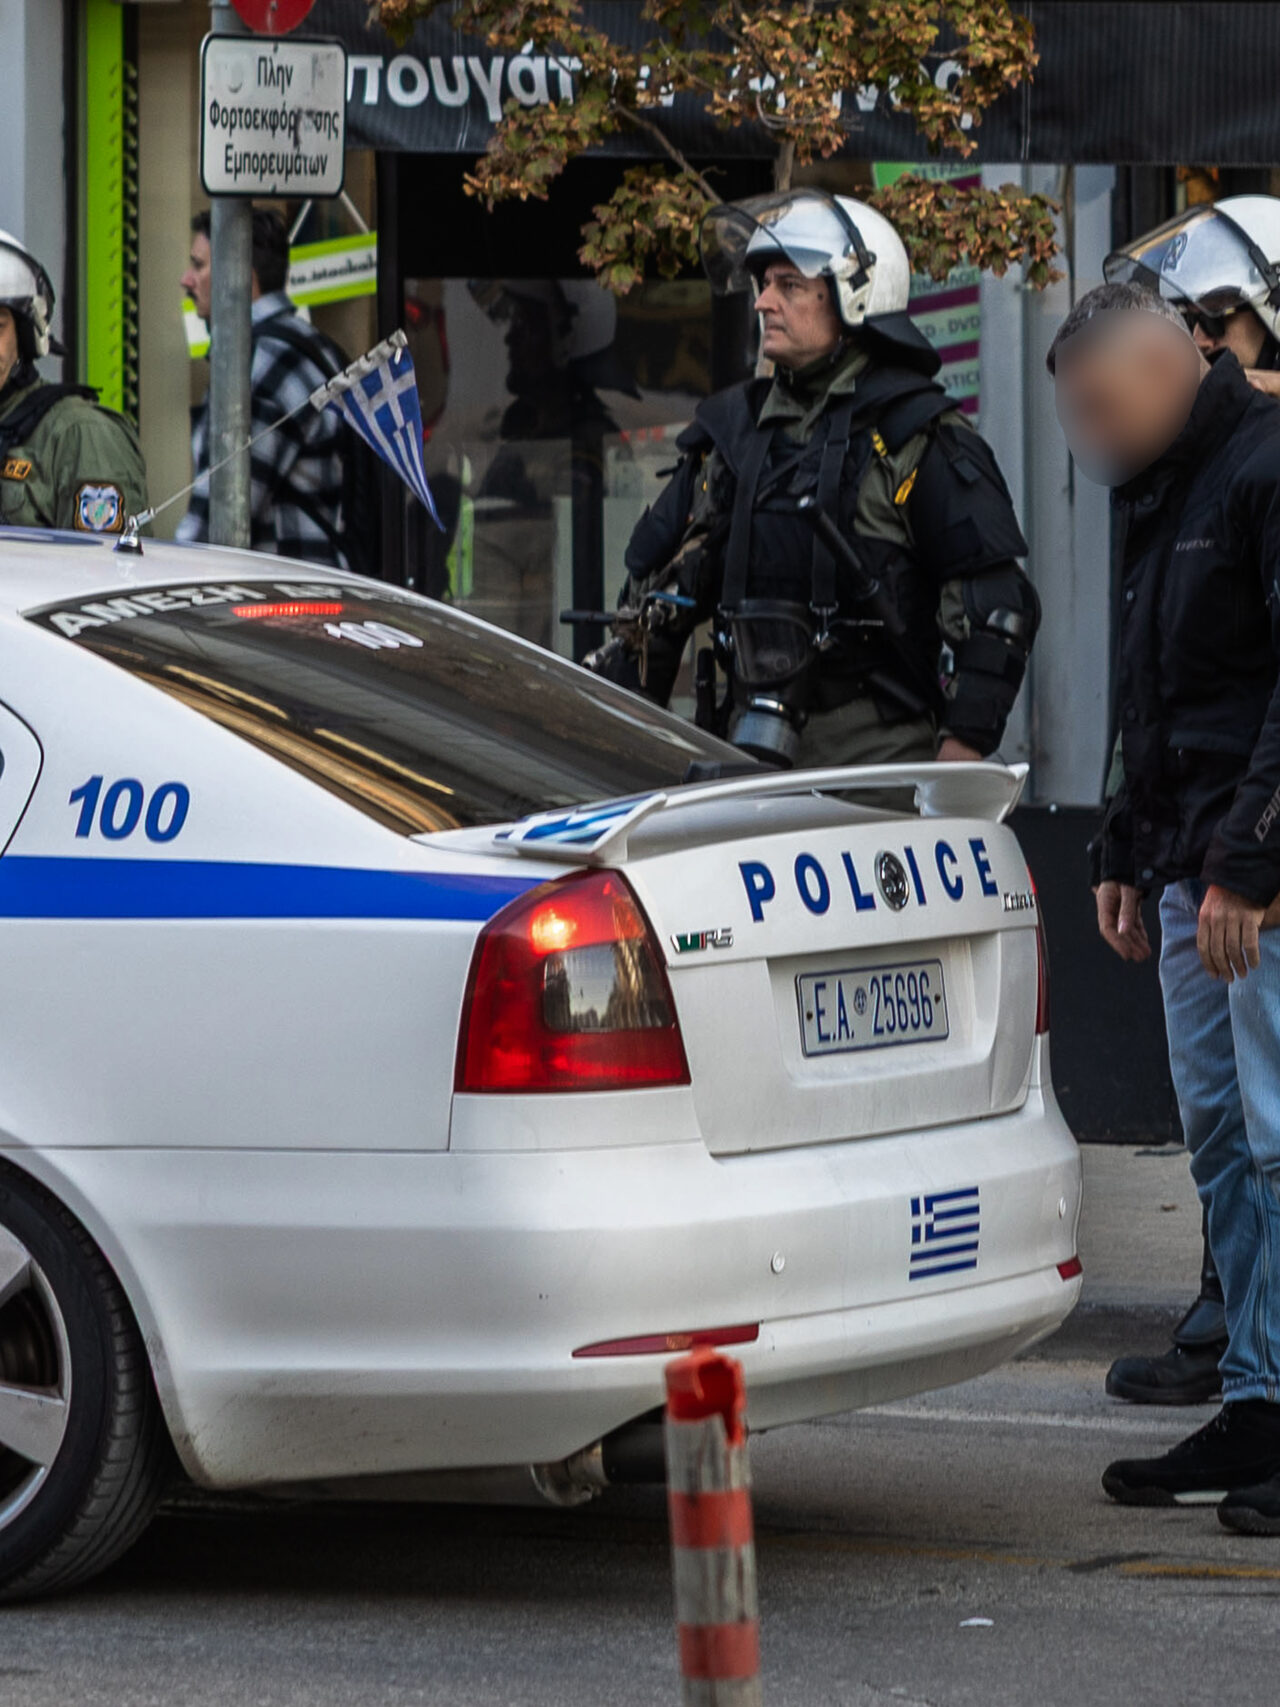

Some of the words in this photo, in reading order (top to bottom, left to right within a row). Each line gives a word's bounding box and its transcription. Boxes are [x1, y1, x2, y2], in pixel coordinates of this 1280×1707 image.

[257, 56, 294, 95] Πλην
[209, 98, 340, 141] Φορτοεκφόρσης
[224, 143, 329, 182] Εμπορευμάτων
[49, 584, 268, 639] ΑΜΕΣΗ
[323, 620, 424, 650] 100
[68, 774, 191, 844] 100
[737, 836, 999, 923] POLICE
[869, 970, 934, 1036] 25696
